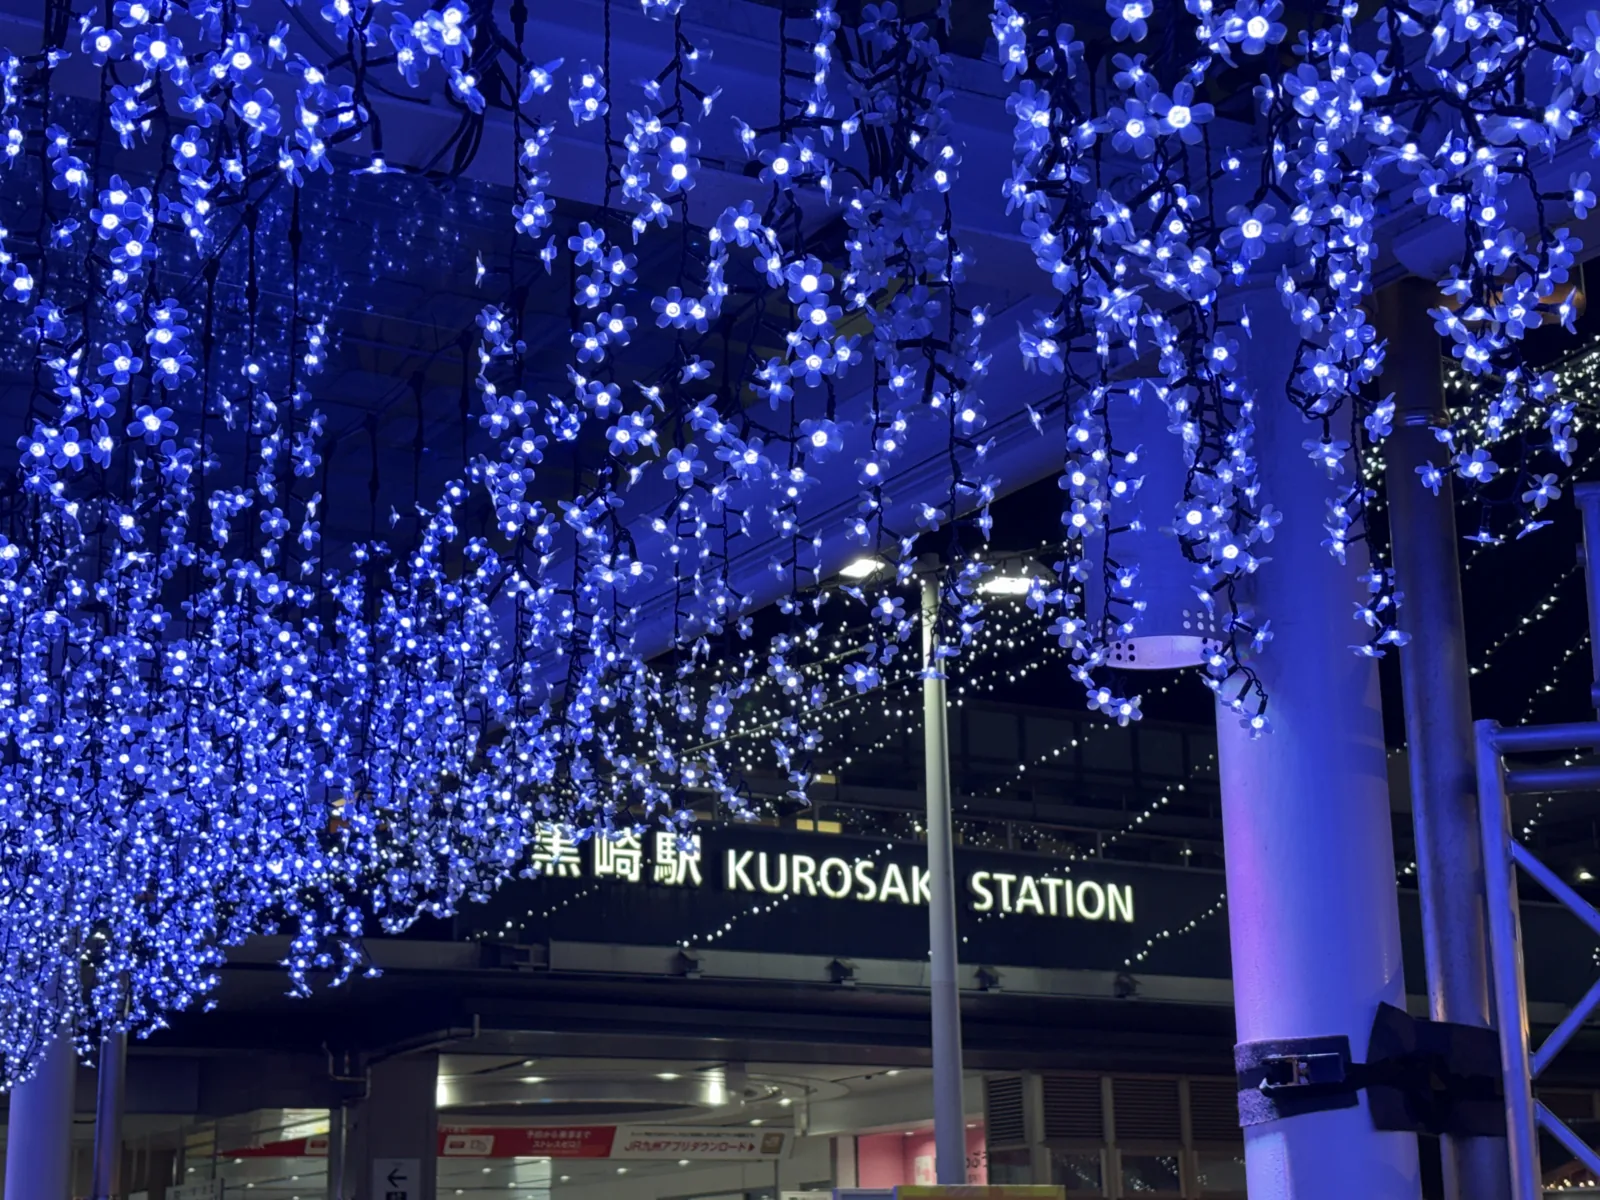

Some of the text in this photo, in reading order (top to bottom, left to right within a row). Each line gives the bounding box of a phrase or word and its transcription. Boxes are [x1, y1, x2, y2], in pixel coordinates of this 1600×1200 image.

[532, 821, 1135, 923] 黒崎駅 KUROSAK STATION
